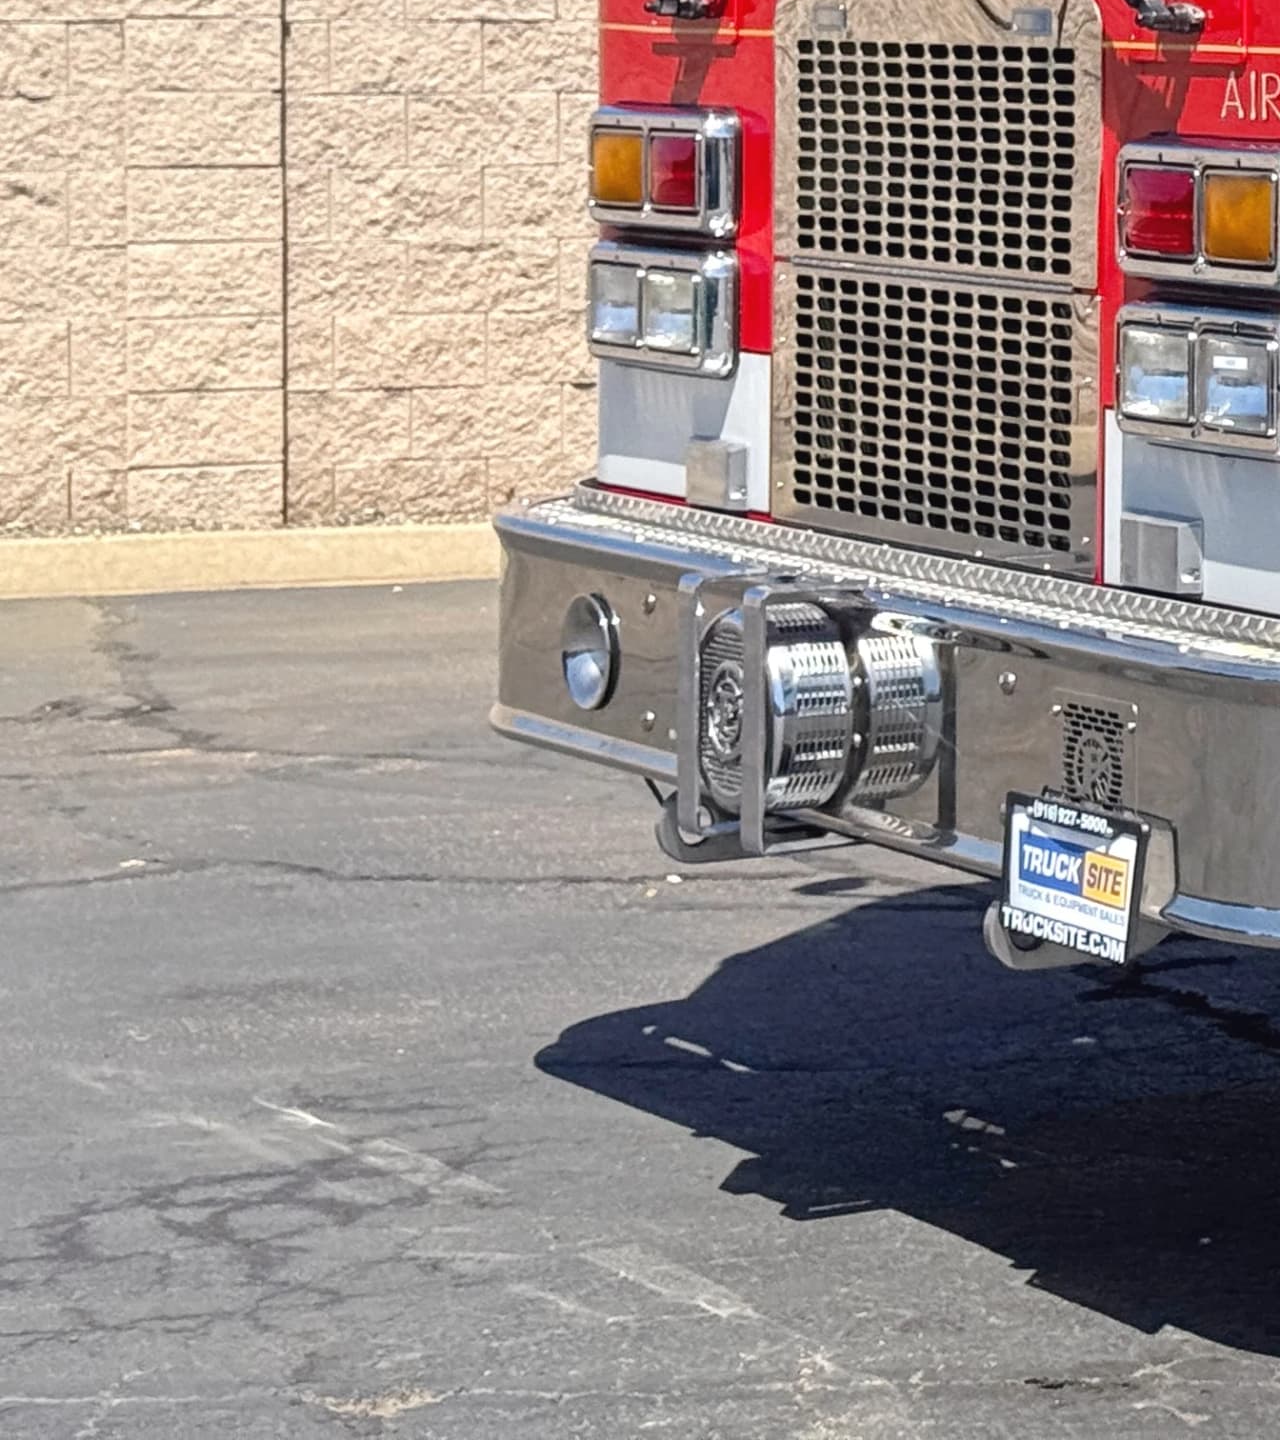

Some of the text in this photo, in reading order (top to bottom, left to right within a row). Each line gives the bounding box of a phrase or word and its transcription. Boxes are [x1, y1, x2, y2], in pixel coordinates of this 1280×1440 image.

[1022, 843, 1124, 897] TRUCK SITE
[1018, 883, 1043, 903] TRUCK
[1053, 895, 1099, 918] EQUIPMENT
[1100, 908, 1126, 927] SALES
[1001, 906, 1126, 964] TRUCKSITE.COM
